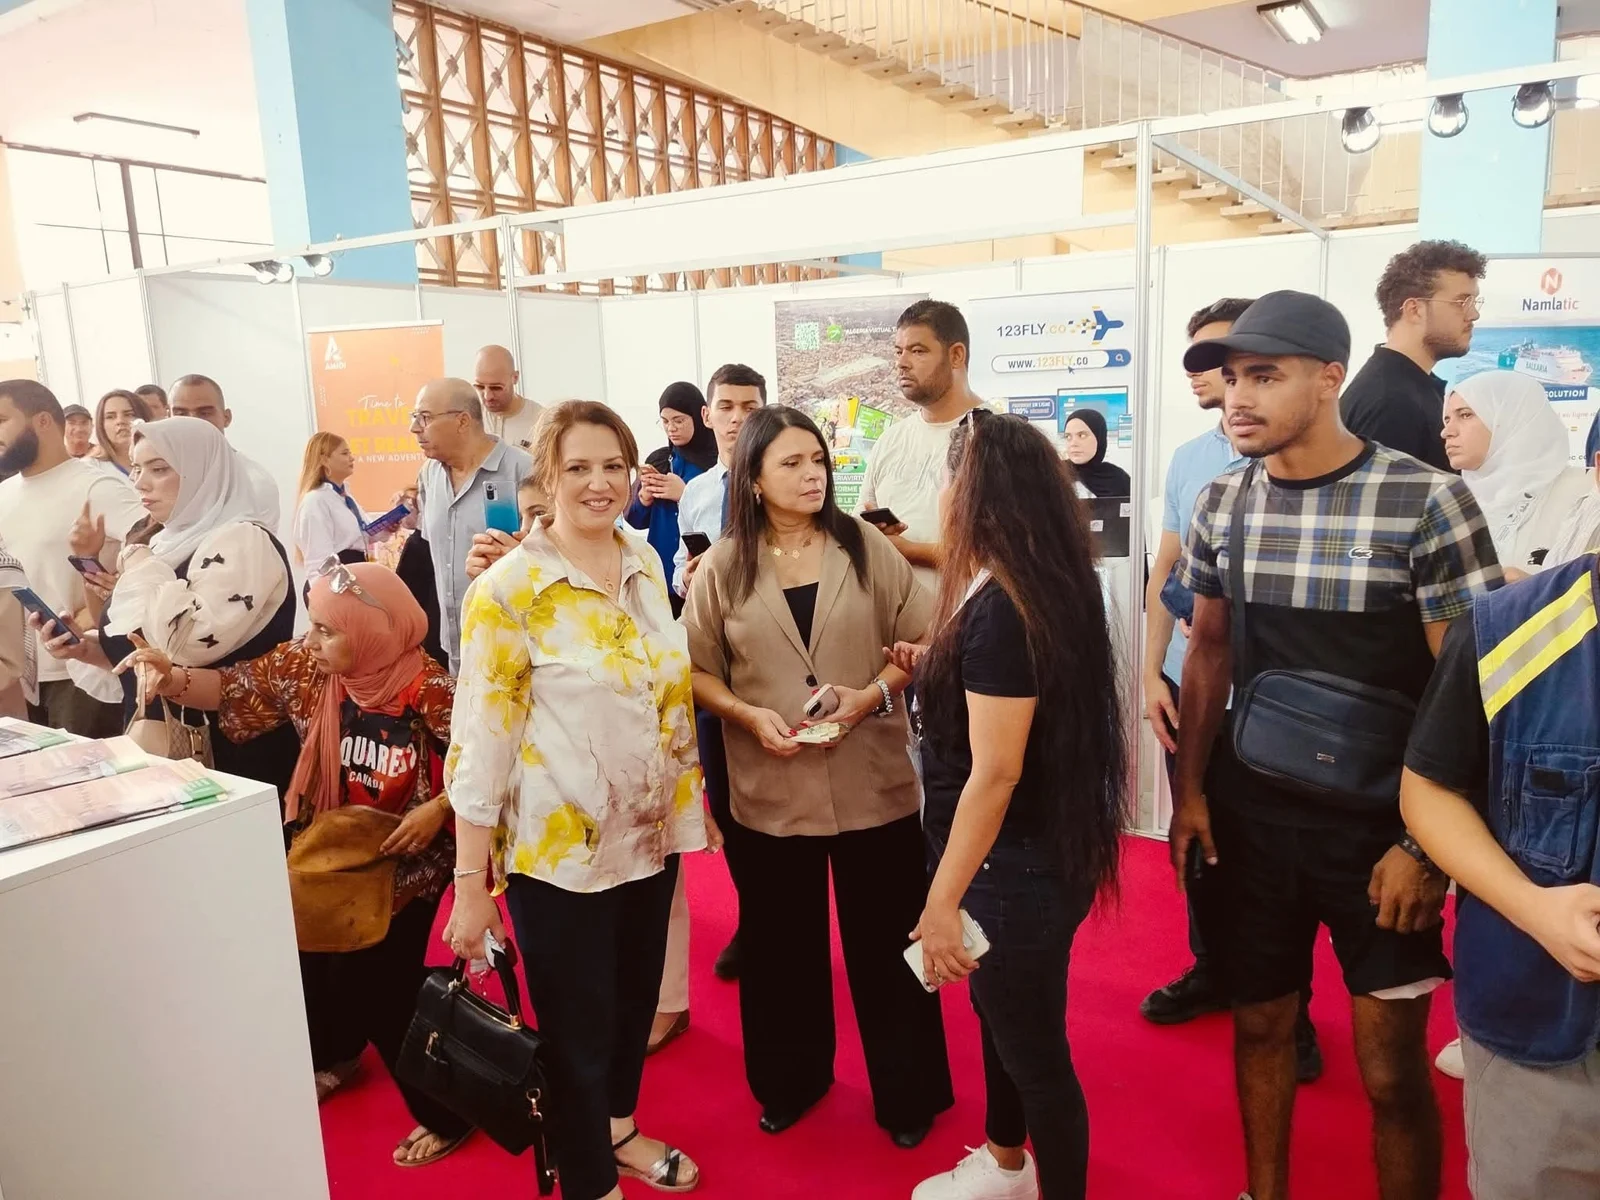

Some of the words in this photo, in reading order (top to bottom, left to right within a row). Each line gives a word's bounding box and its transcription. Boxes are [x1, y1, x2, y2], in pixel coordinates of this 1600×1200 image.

[1522, 297, 1580, 311] Namlatic
[358, 394, 392, 410] Time
[394, 394, 406, 411] to
[367, 455, 385, 463] NEW
[349, 771, 385, 791] CANADA
